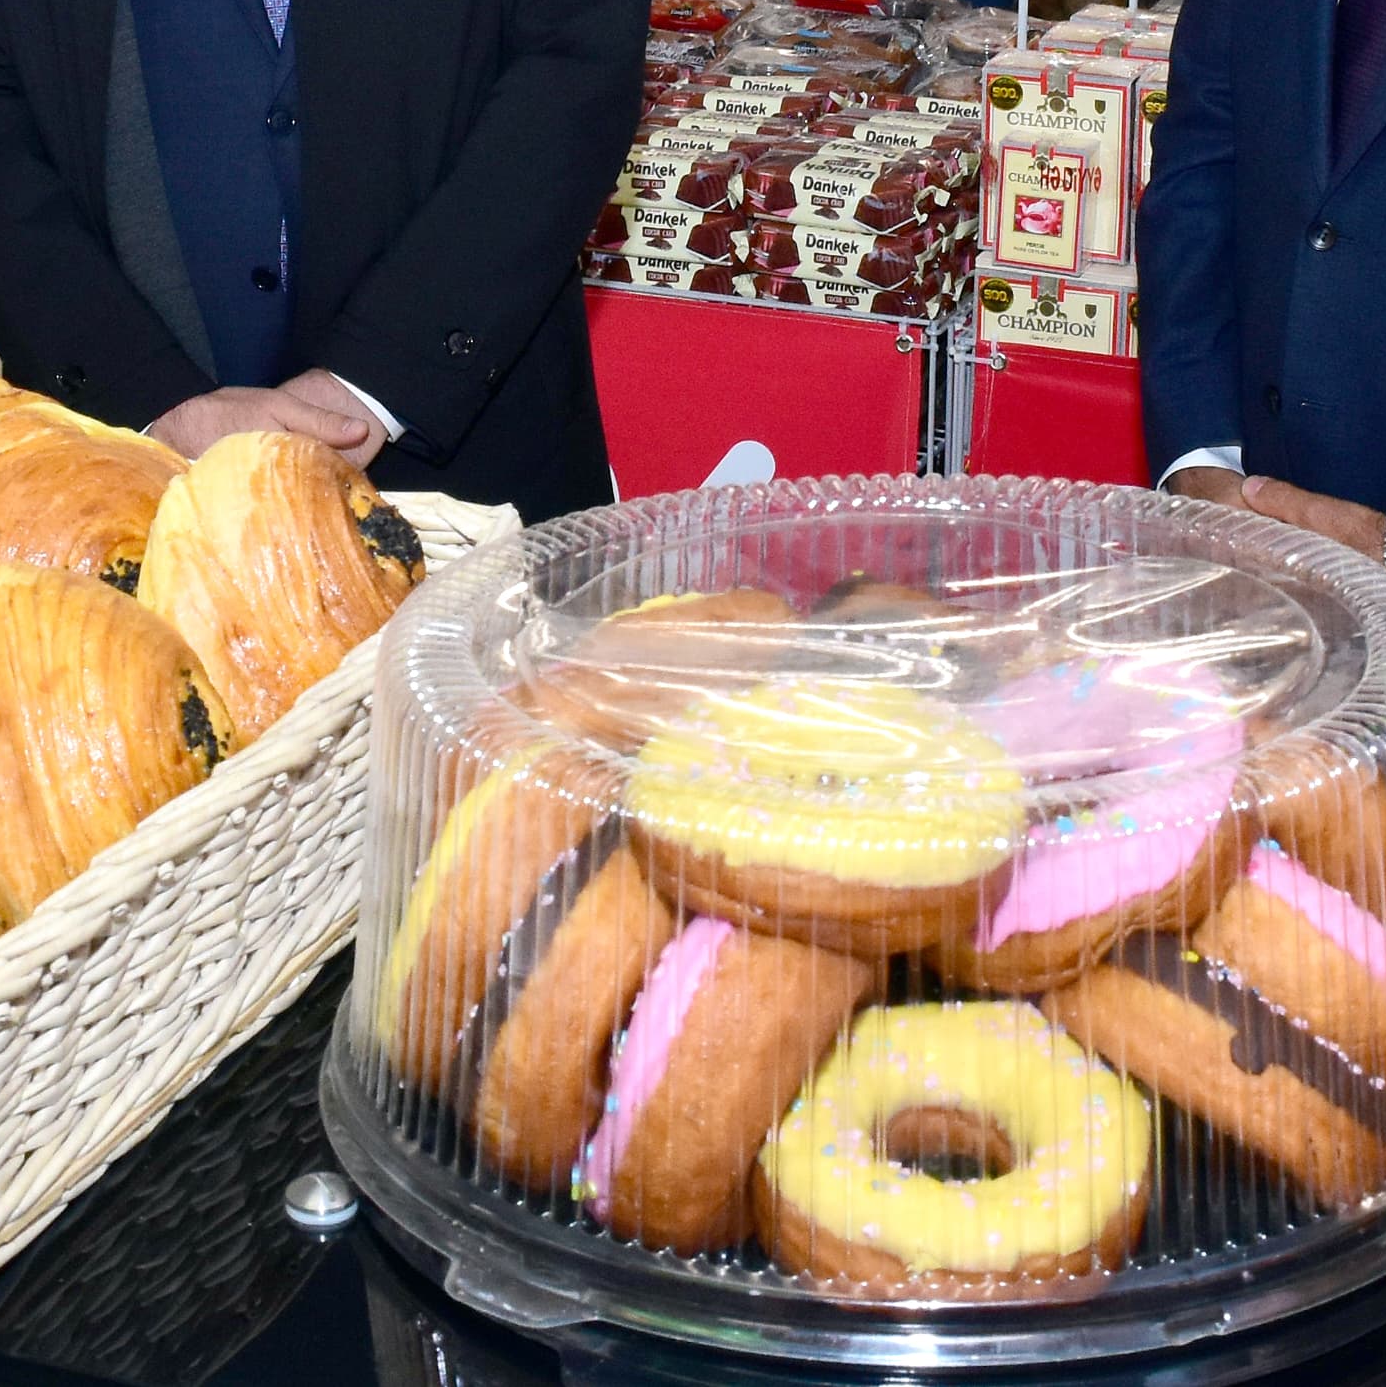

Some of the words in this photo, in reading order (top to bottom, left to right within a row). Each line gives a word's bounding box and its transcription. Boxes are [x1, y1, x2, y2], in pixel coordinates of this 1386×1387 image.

[715, 99, 768, 116] Dankek
[928, 101, 981, 119] Dankek
[1006, 111, 1107, 134] CHAMPION
[865, 129, 919, 149] Dankek
[623, 159, 677, 180] Dankek
[802, 175, 857, 197] Dankek
[634, 208, 689, 228] Dankek
[805, 233, 860, 255] Dankek
[997, 313, 1096, 338] CHAMPION
